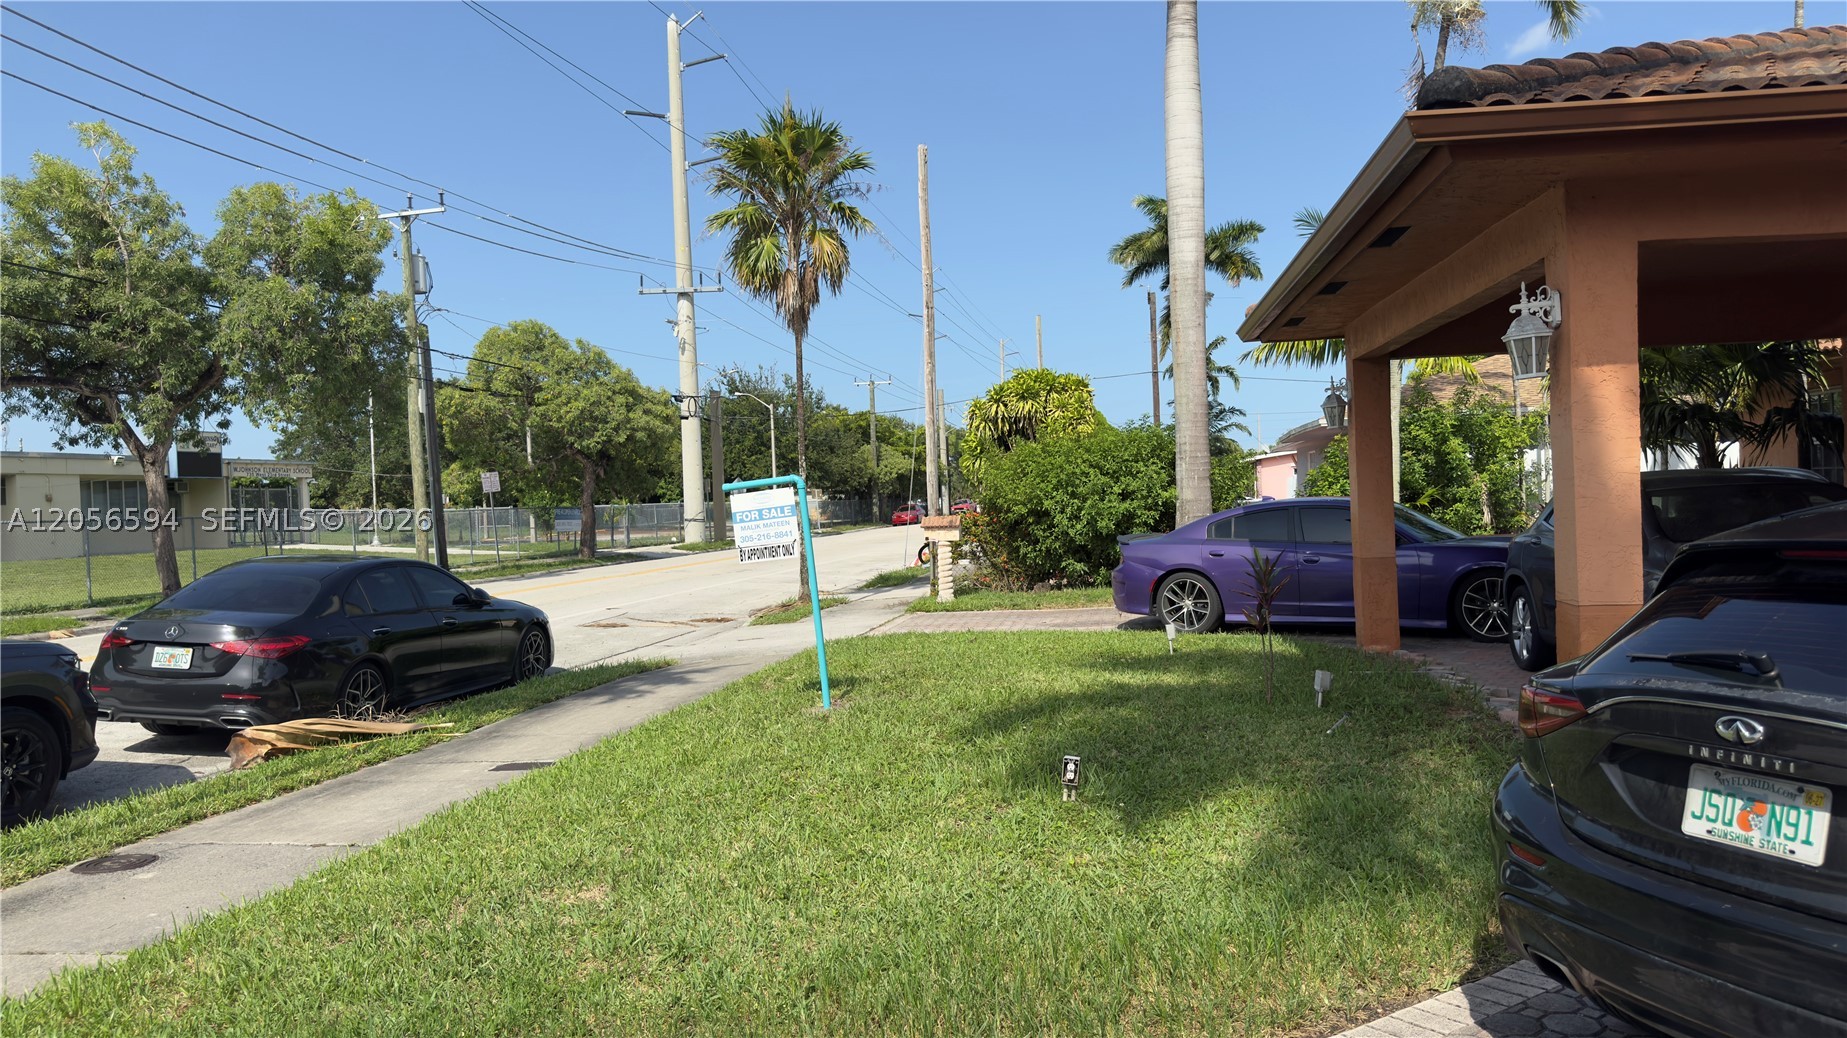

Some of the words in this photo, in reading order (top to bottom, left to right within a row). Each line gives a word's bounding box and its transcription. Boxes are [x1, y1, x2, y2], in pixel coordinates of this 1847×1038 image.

[736, 511, 759, 522] FOR
[762, 506, 792, 518] SALE
[740, 523, 761, 531] MALIK
[763, 520, 790, 528] MATEEN
[740, 530, 793, 543] 305-216-8841
[740, 549, 747, 562] BY
[747, 545, 781, 561] APPOINTMENT
[782, 543, 795, 556] ONLY
[1688, 745, 1795, 773] INFINITI
[1690, 786, 1737, 828] JSQ
[1766, 801, 1815, 847] N91
[1711, 826, 1755, 847] SUNSHINE
[1759, 837, 1789, 854] STATE
